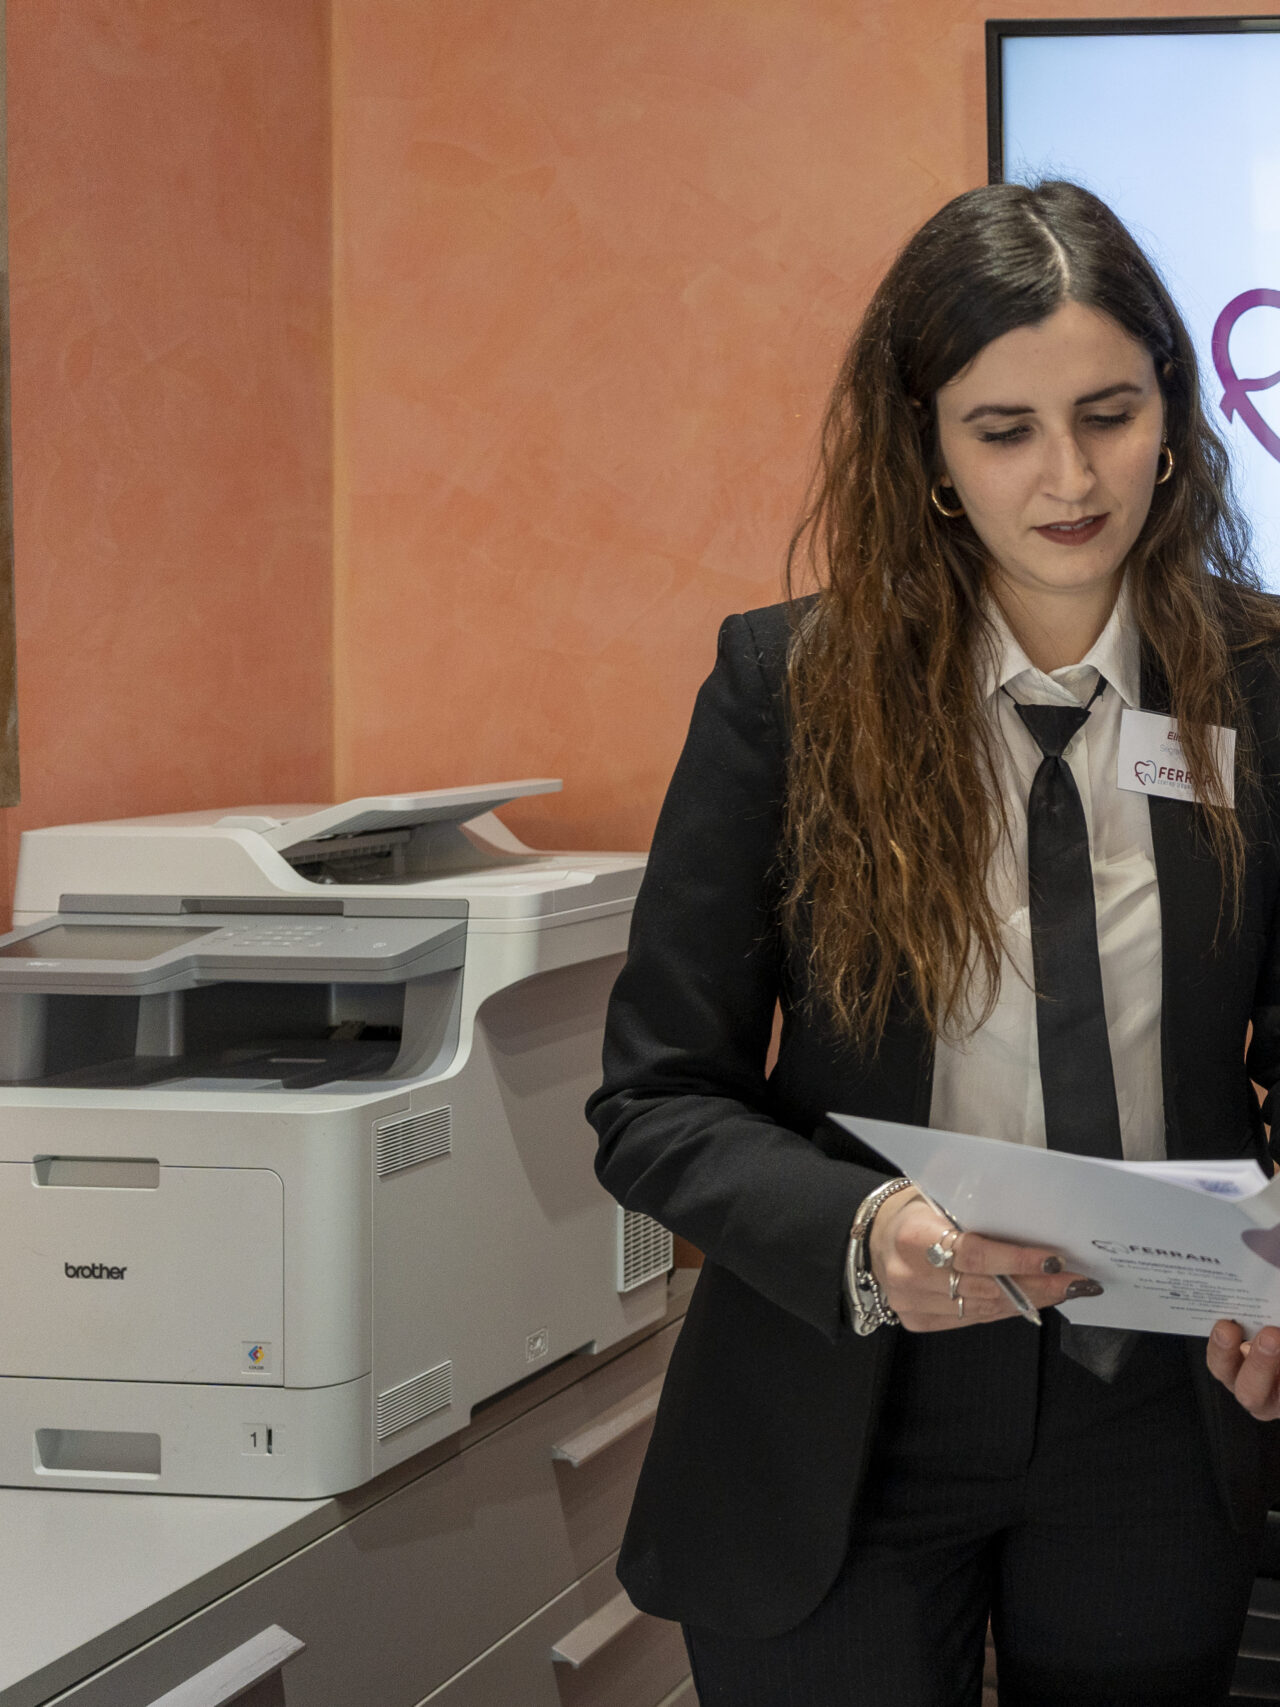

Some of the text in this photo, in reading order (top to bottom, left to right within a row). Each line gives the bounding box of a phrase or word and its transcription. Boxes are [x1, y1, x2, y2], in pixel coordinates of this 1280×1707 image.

[1128, 1245, 1222, 1265] FERRARI
[64, 1262, 127, 1280] brother
[250, 1432, 258, 1447] 1
